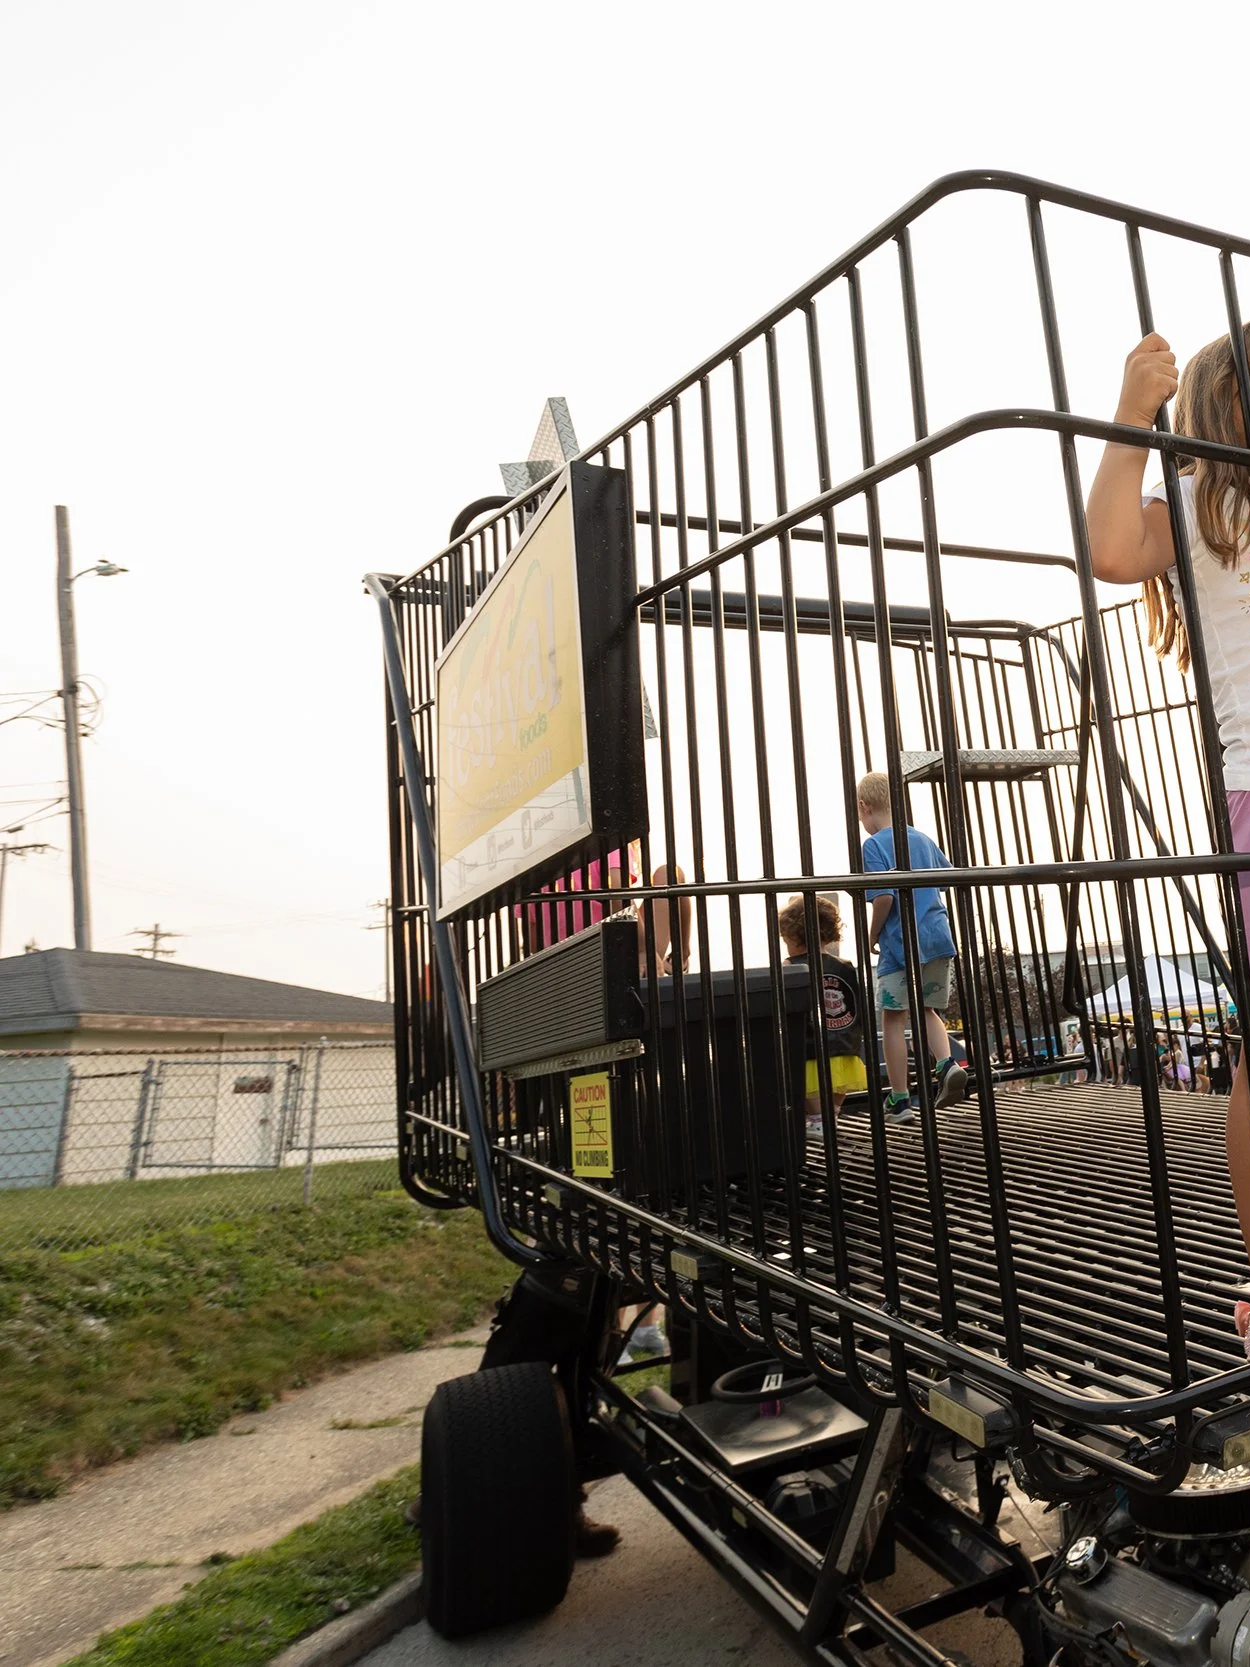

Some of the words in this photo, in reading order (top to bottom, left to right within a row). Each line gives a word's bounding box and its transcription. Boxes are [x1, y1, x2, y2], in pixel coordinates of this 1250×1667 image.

[445, 573, 563, 803] festival
[518, 711, 549, 752] foods
[574, 1084, 606, 1104] CAUTION
[575, 1150, 583, 1167] NO
[583, 1149, 609, 1168] CLIMBING
